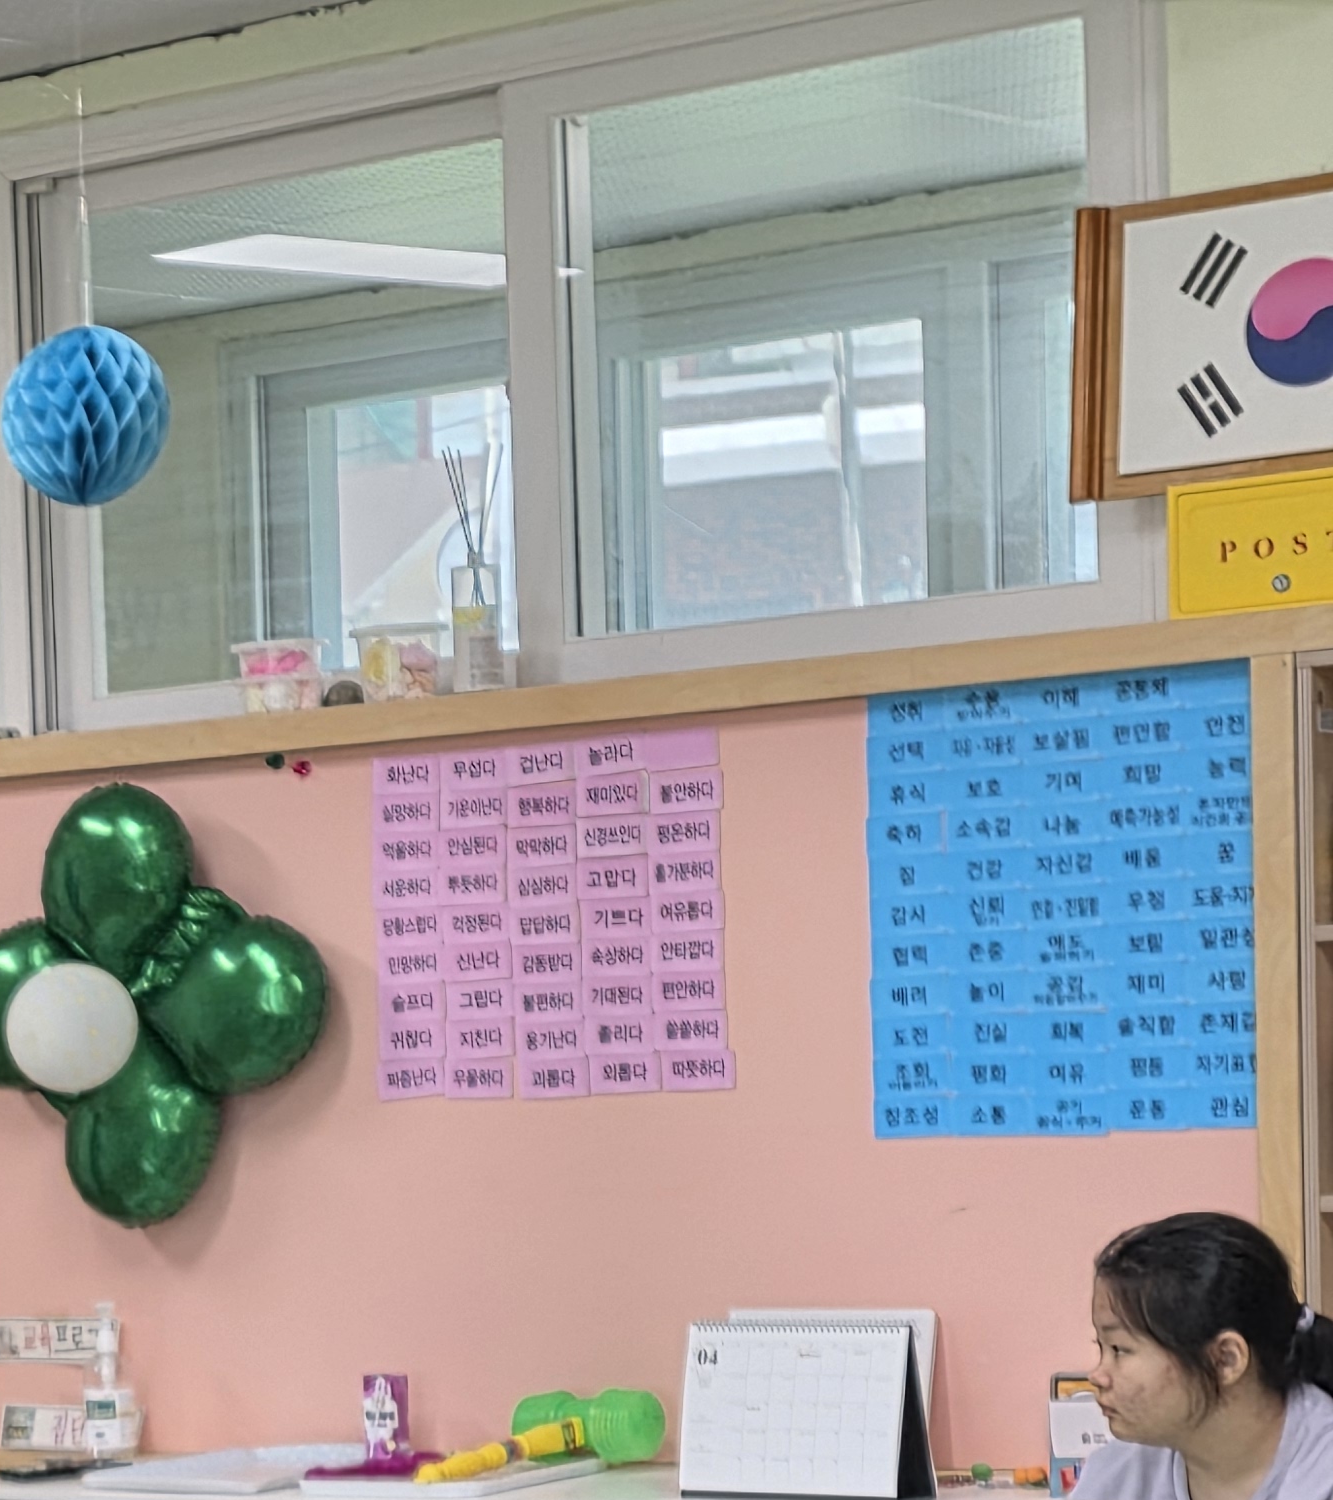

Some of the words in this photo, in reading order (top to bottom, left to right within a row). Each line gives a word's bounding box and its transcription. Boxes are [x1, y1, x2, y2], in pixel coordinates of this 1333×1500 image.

[889, 741, 924, 762] 선택
[454, 759, 495, 780] 무섭다
[520, 751, 563, 774] 겁난다
[386, 765, 429, 784] 화난다
[587, 784, 637, 804] 재미있다
[661, 779, 713, 804] 불안하다
[891, 784, 925, 804] 휴식
[967, 779, 1001, 797] 보호
[383, 802, 431, 822] 실망하다
[519, 796, 569, 816] 행복하다
[585, 825, 641, 846] 신경쓰인다
[657, 821, 710, 843] 평온하다
[957, 818, 1010, 838] 소속감
[383, 839, 431, 860] 억울하다
[448, 837, 497, 856] 안심된다
[516, 835, 567, 857] 막막하다
[656, 860, 713, 882] 홀가분하다
[1036, 853, 1092, 875] 자신감
[383, 877, 431, 897] 서운하다
[448, 874, 497, 894] 뿌듯하다
[519, 875, 568, 896] 심심하다
[587, 868, 636, 888] 고맙다
[595, 908, 643, 928] 기쁘다
[661, 900, 713, 921] 여유롭다
[383, 915, 437, 936] 당황스럽다
[453, 913, 501, 933] 걱정된다
[520, 914, 570, 935] 답답하다
[592, 946, 643, 966] 속상하다
[661, 940, 713, 960] 안타깝다
[389, 954, 437, 975] 민망하다
[457, 950, 500, 971] 신난다
[523, 954, 573, 973] 감동받다
[460, 989, 502, 1008] 그립다
[592, 987, 642, 1005] 기대된다
[663, 980, 714, 999] 편안하다
[393, 992, 433, 1013] 슬프다
[524, 992, 573, 1011] 불편하다
[391, 1029, 432, 1049] 귀찮다
[461, 1027, 502, 1048] 지친다
[599, 1021, 642, 1043] 졸리다
[667, 1020, 719, 1039] 쓸쓸하다
[894, 1027, 928, 1046] 도전
[526, 1030, 577, 1050] 용기난다
[387, 1067, 436, 1089] 짜증난다
[454, 1069, 503, 1088] 우울하다
[532, 1069, 575, 1088] 괴롭다
[603, 1062, 646, 1081] 외롭다
[673, 1059, 725, 1078] 따뜻하다
